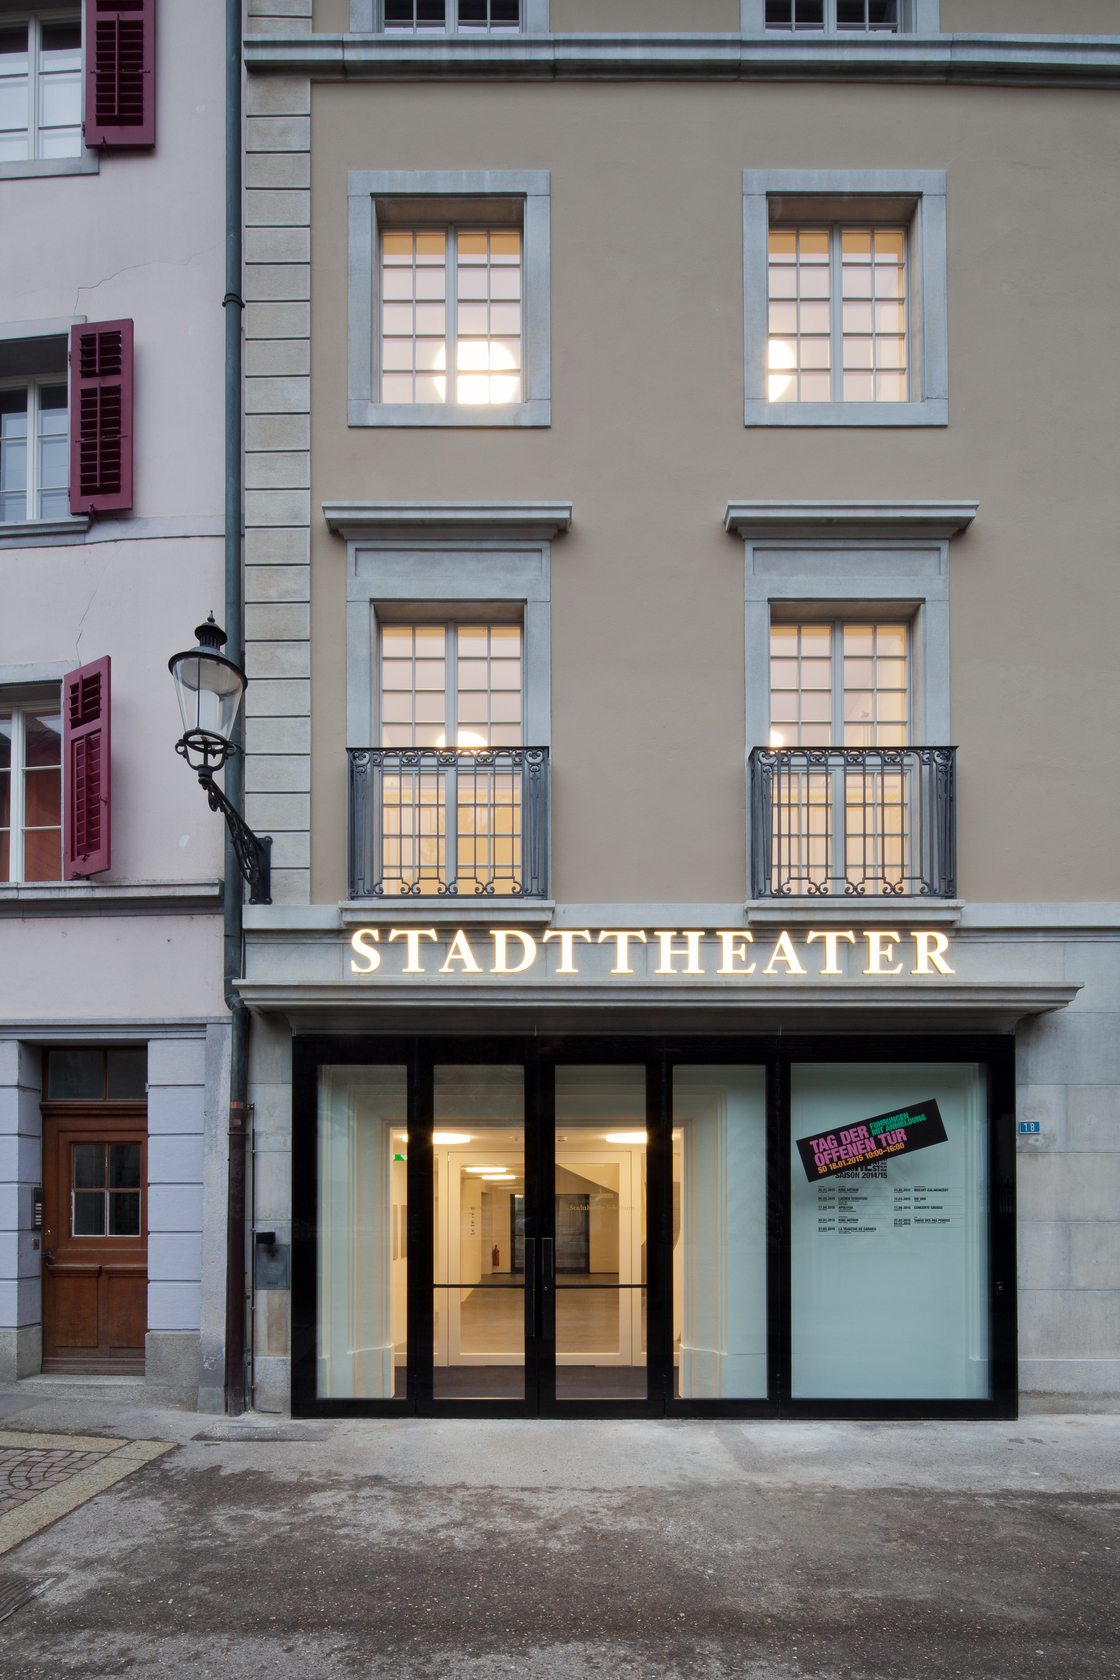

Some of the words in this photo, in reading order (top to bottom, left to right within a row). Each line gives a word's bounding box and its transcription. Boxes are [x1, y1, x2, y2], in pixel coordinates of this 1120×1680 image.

[350, 928, 956, 976] STADTTHEATER
[871, 1127, 884, 1136] MIT
[885, 1114, 926, 1132] ANMELDUNG
[1023, 1122, 1035, 1132] 18
[810, 1135, 838, 1153] TAG
[840, 1125, 869, 1145] DER
[814, 1137, 877, 1167] OFFENEN
[878, 1128, 908, 1147] TÜR
[817, 1165, 828, 1174] SO
[828, 1155, 864, 1171] 18.01.2015
